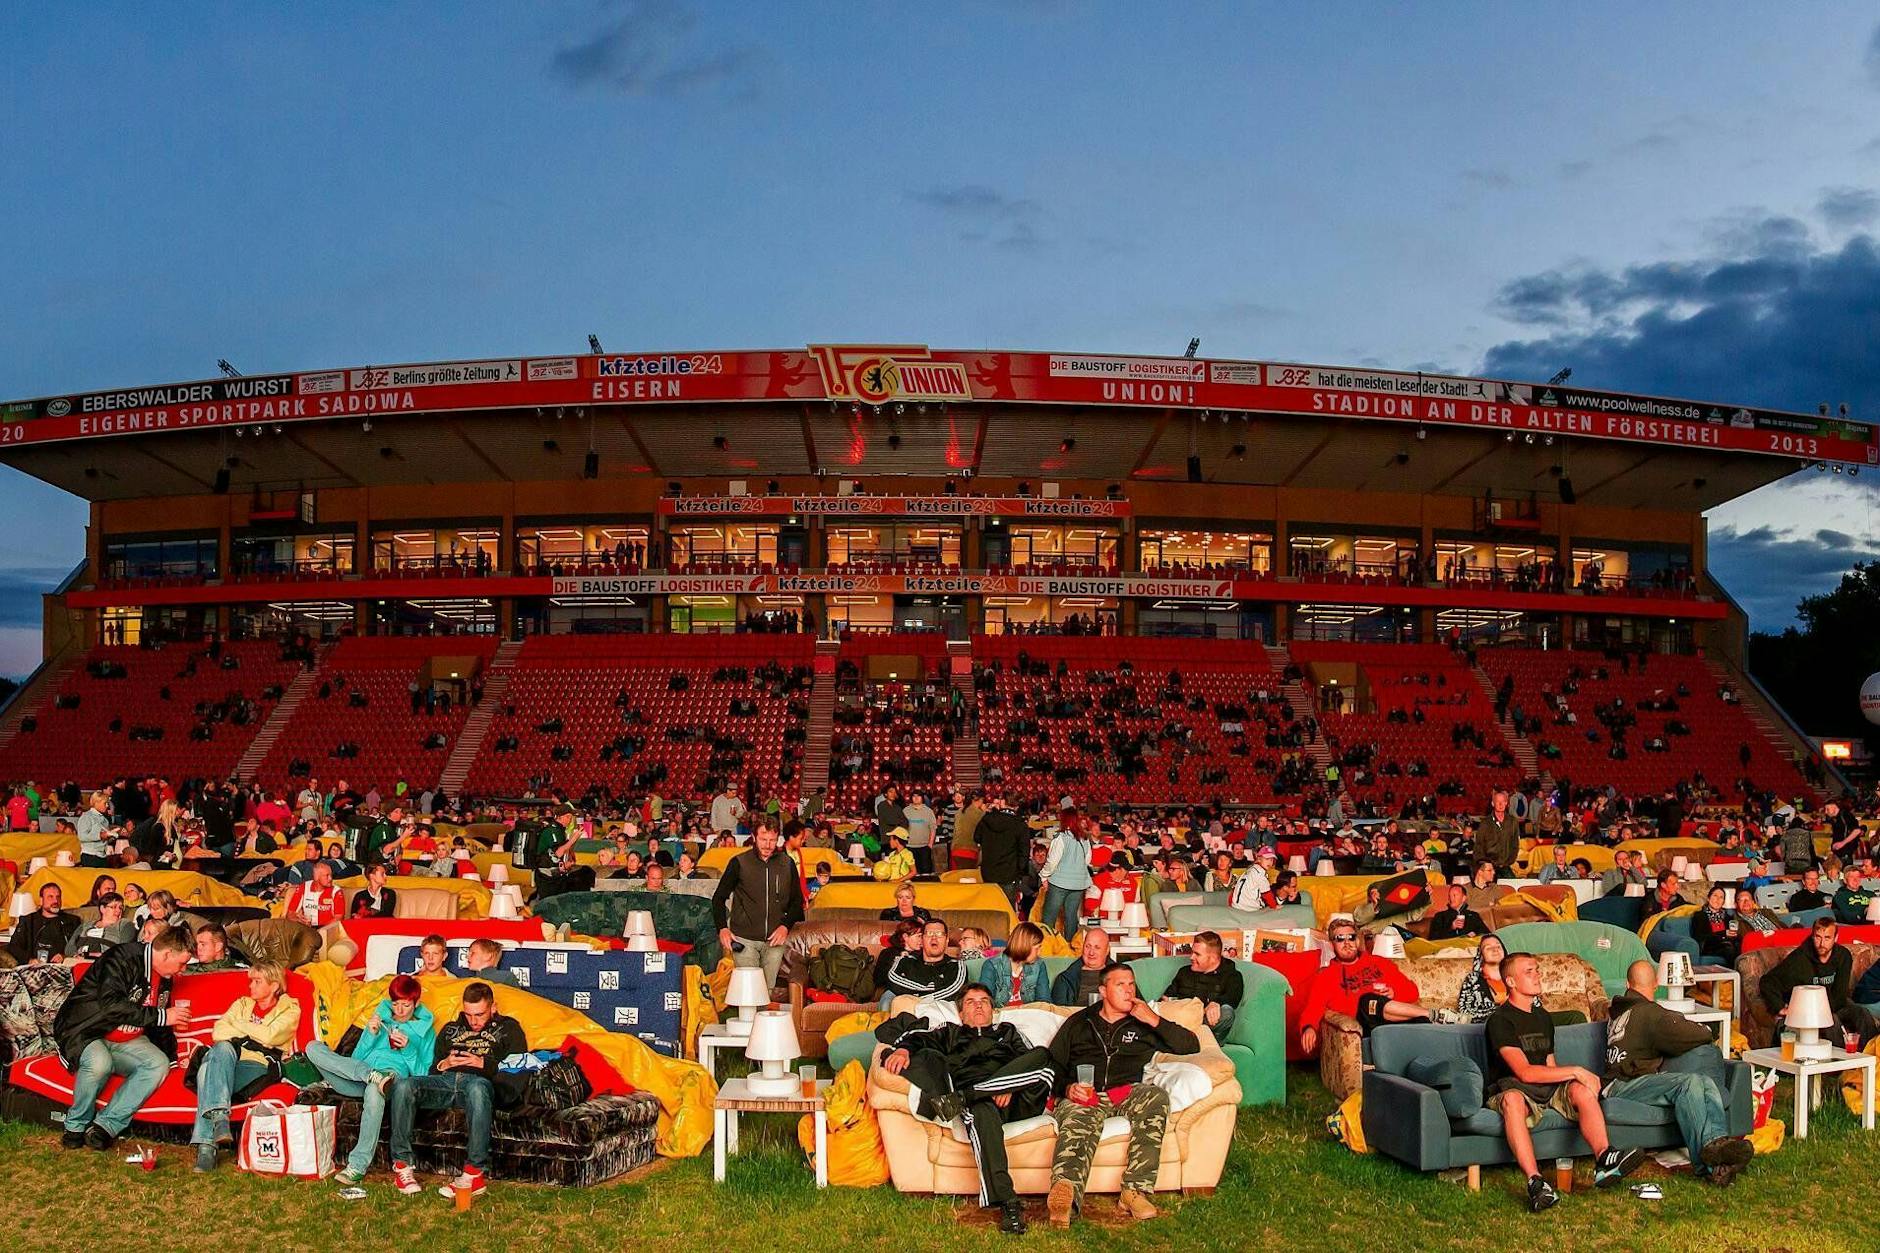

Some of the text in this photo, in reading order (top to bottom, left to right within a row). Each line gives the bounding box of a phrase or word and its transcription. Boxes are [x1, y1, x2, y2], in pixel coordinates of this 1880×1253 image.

[599, 355, 722, 376] kfzteile24
[1050, 361, 1189, 375] DIE BAUSTOFF LOGISTIKER
[393, 370, 426, 385] Berlins
[428, 368, 462, 385] größte
[463, 367, 501, 381] Zeitung
[899, 367, 966, 394] UNION
[593, 380, 1194, 404] EISERN UNION!
[1318, 372, 1335, 386] hat
[1337, 373, 1352, 388] die
[1355, 375, 1394, 391] meisten
[1422, 380, 1439, 395] der
[1440, 381, 1468, 397] Stadt!
[83, 385, 213, 412] EBERSWALDER
[224, 379, 291, 399] WURST
[80, 411, 168, 434] EIGENER
[179, 398, 306, 426] SPORTPARK
[319, 392, 415, 415] SADOWA
[1566, 394, 1701, 419] www.poolwellness.de
[1313, 392, 1817, 454] STADION AN DER ALTEN FÖRSTEREI 2013
[675, 498, 764, 513] kfzteile24
[793, 498, 883, 513] kfzteile24
[905, 499, 996, 514] kfzteile24
[1025, 500, 1114, 515] kfzteile24
[554, 579, 743, 593] DIE BAUSTOFF LOGISTIKER
[778, 577, 881, 592] kfzteile24
[905, 577, 1007, 592] kfzteile24
[1020, 581, 1211, 596] DIE BAUSTOFF LOGISTIKER
[263, 1143, 275, 1152] M
